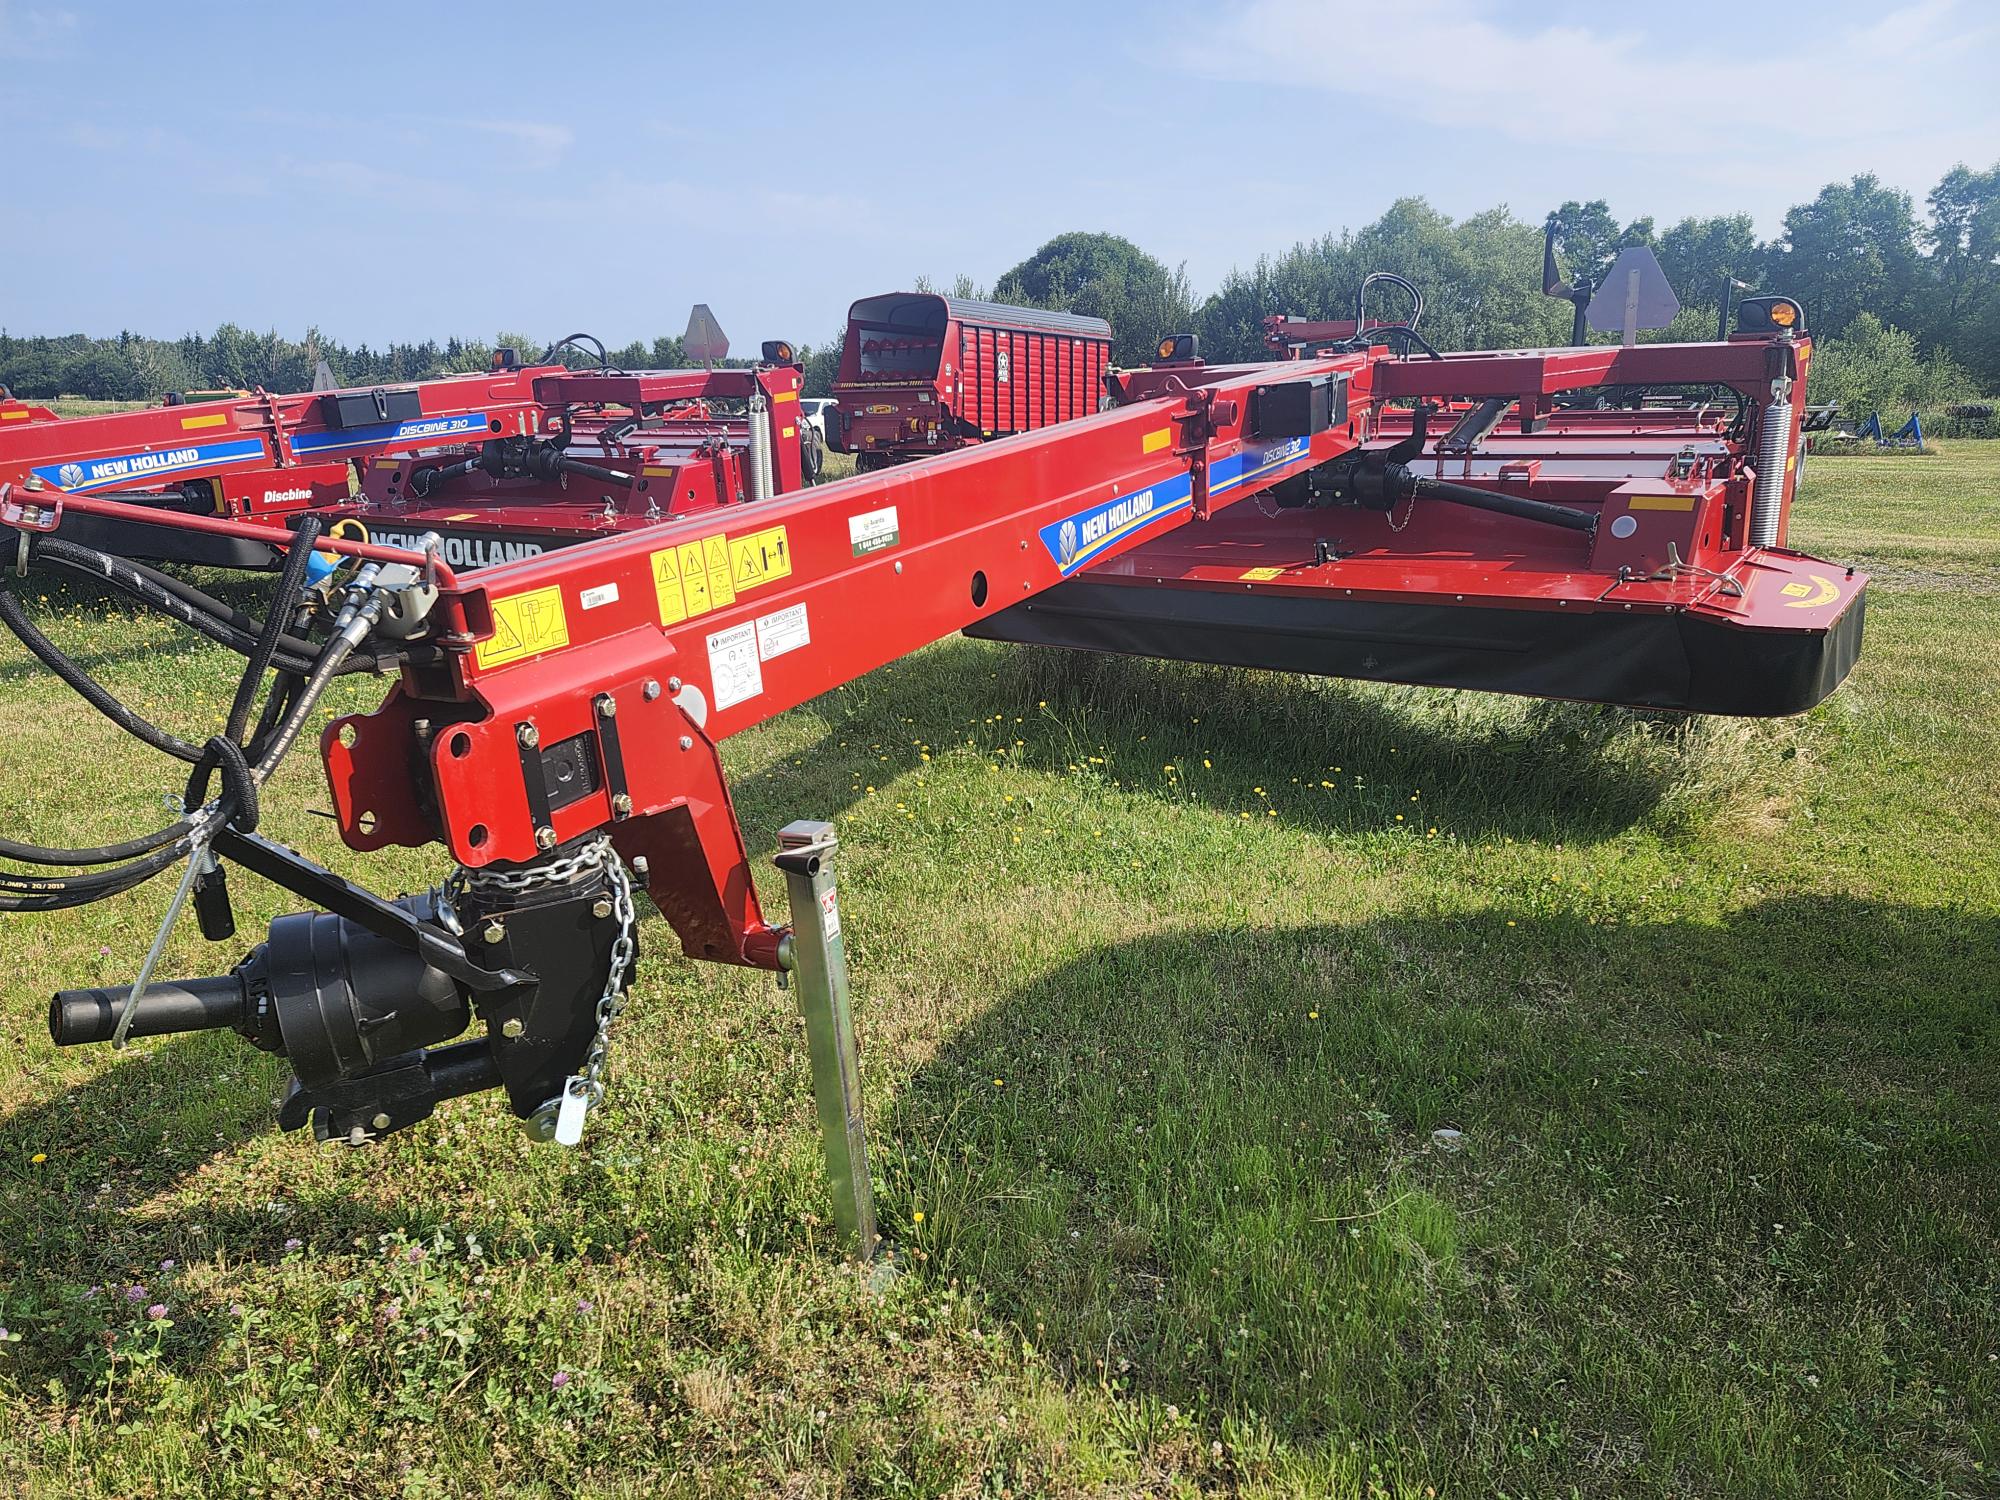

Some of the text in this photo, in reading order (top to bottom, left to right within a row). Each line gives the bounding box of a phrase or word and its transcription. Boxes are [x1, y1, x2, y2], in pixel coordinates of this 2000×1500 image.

[399, 419, 468, 436] DISCBINE 310
[1262, 438, 1302, 465] DISCBINE 312
[92, 449, 199, 479] NEW HOLLAND
[264, 488, 312, 503] Discbine
[1082, 490, 1153, 545] NEW HOLLAND
[771, 608, 803, 624] IMPORTANT
[720, 628, 752, 646] IMPORTANT
[0, 879, 28, 889] 3.0MPa
